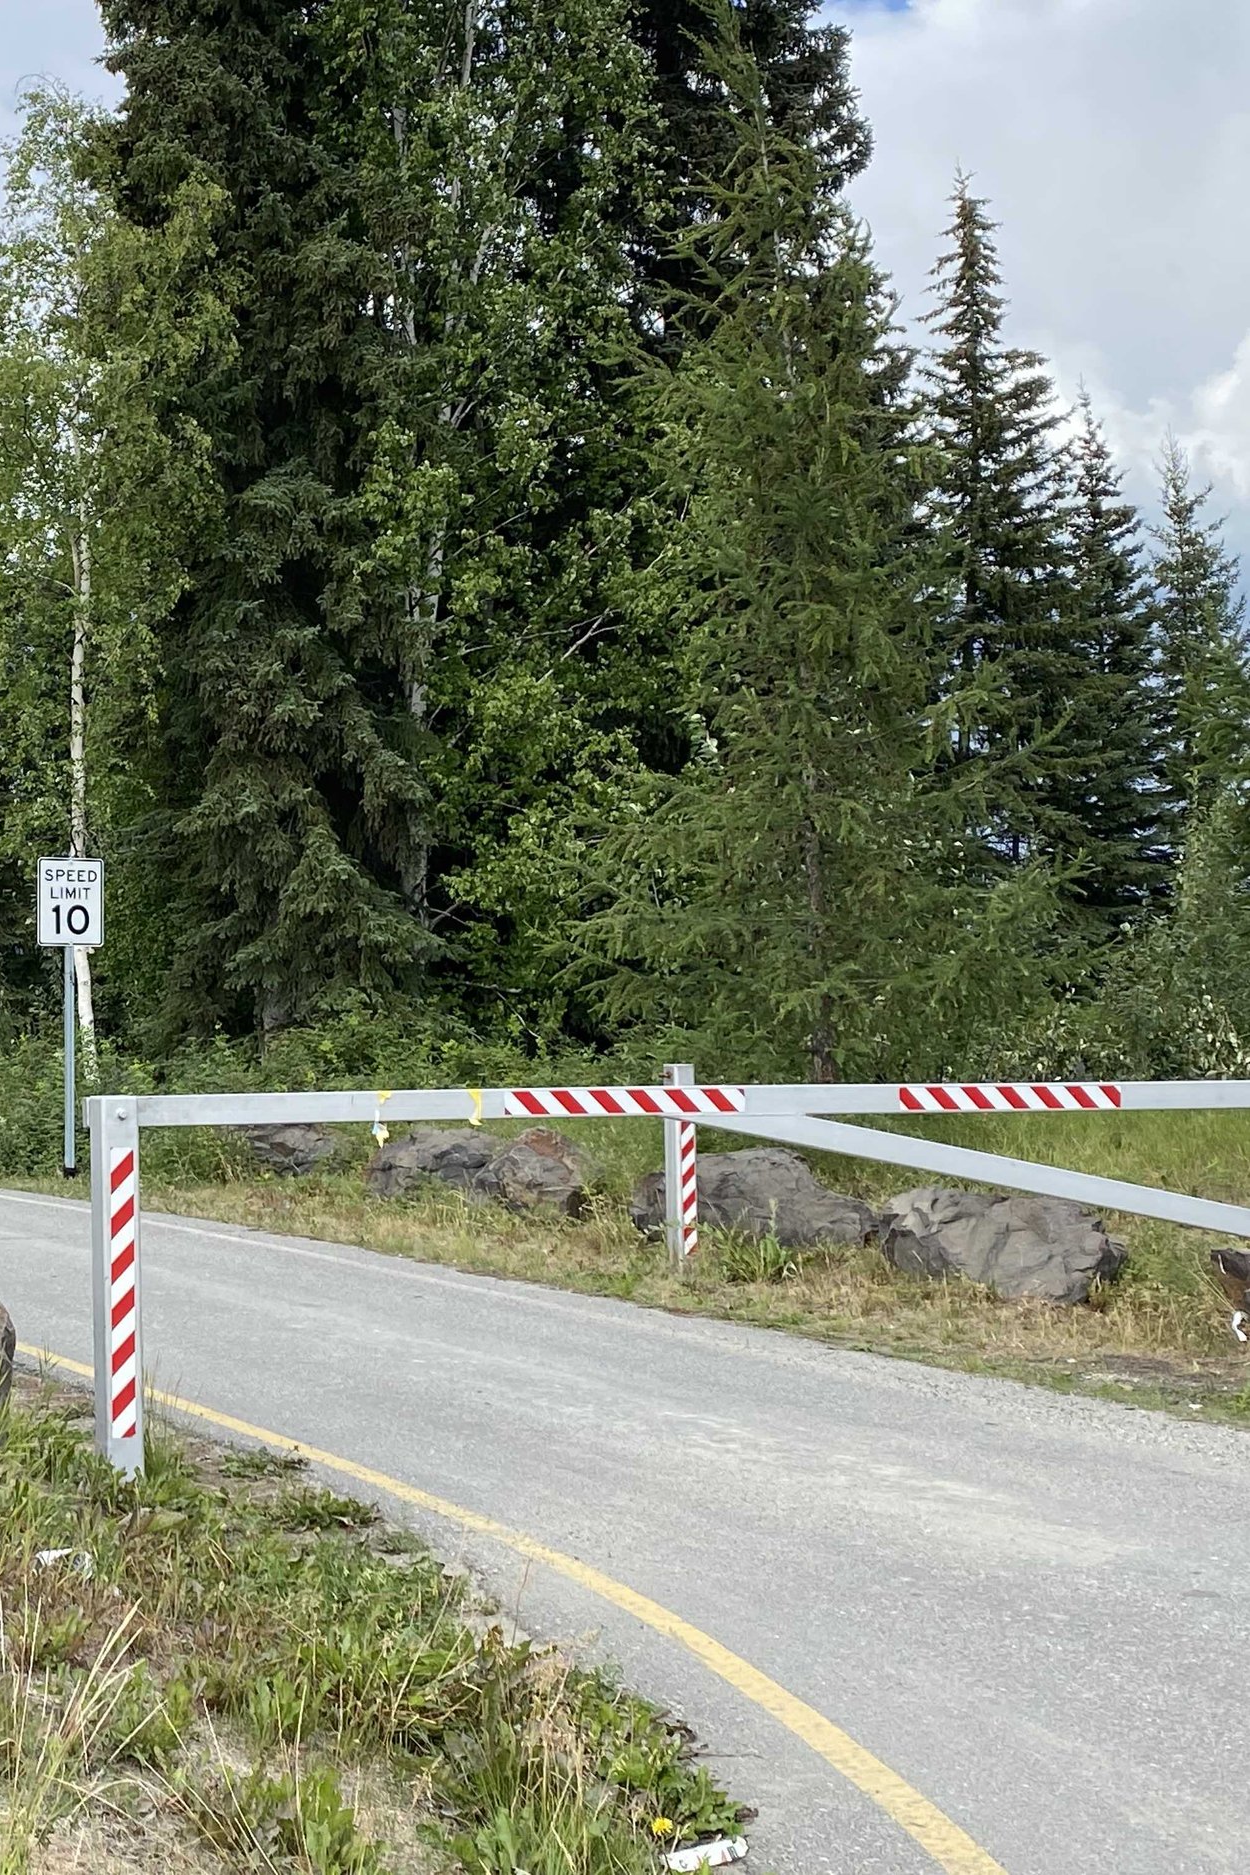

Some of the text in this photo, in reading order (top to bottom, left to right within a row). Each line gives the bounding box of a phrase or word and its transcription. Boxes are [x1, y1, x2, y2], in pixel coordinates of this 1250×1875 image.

[44, 868, 98, 882] SPEED
[50, 886, 91, 900] LIMIT
[51, 904, 90, 935] 10
